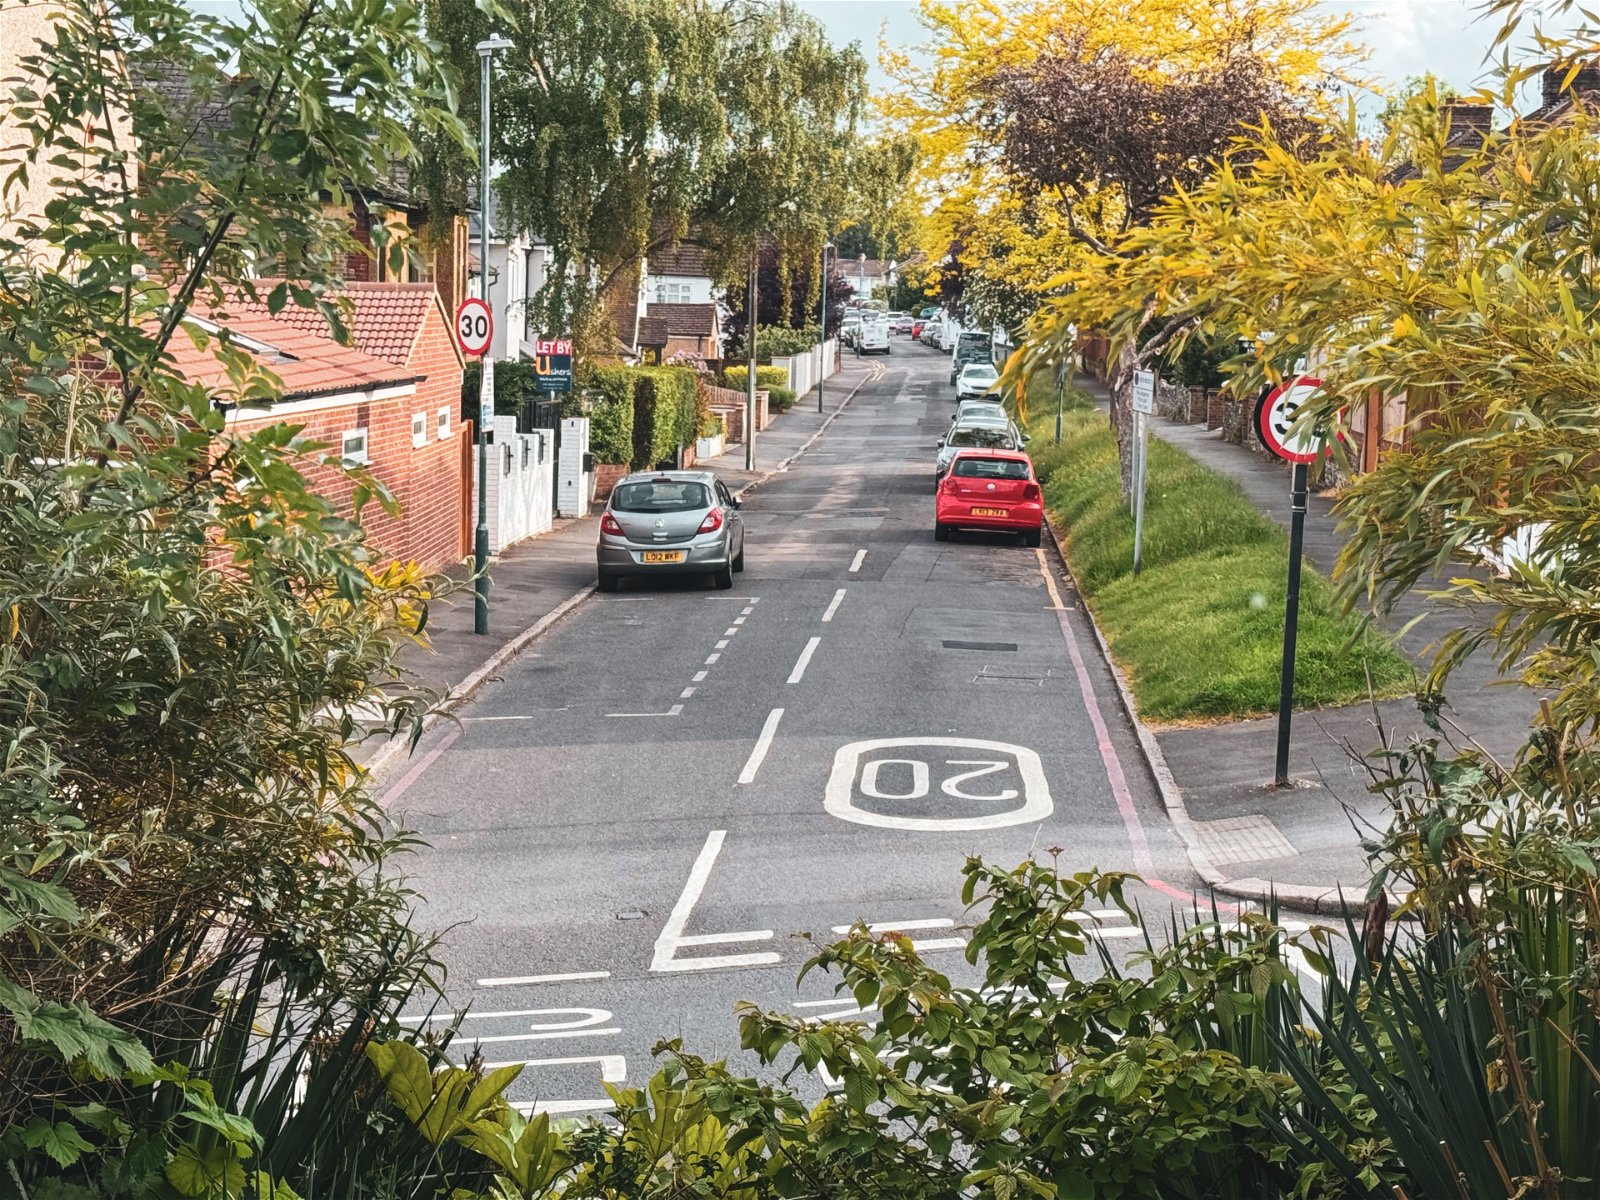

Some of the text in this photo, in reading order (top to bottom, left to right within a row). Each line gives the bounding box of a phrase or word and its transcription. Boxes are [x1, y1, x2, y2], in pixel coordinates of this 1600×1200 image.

[461, 315, 488, 338] 30
[537, 341, 571, 354] LET BY
[860, 759, 1018, 800] 20
